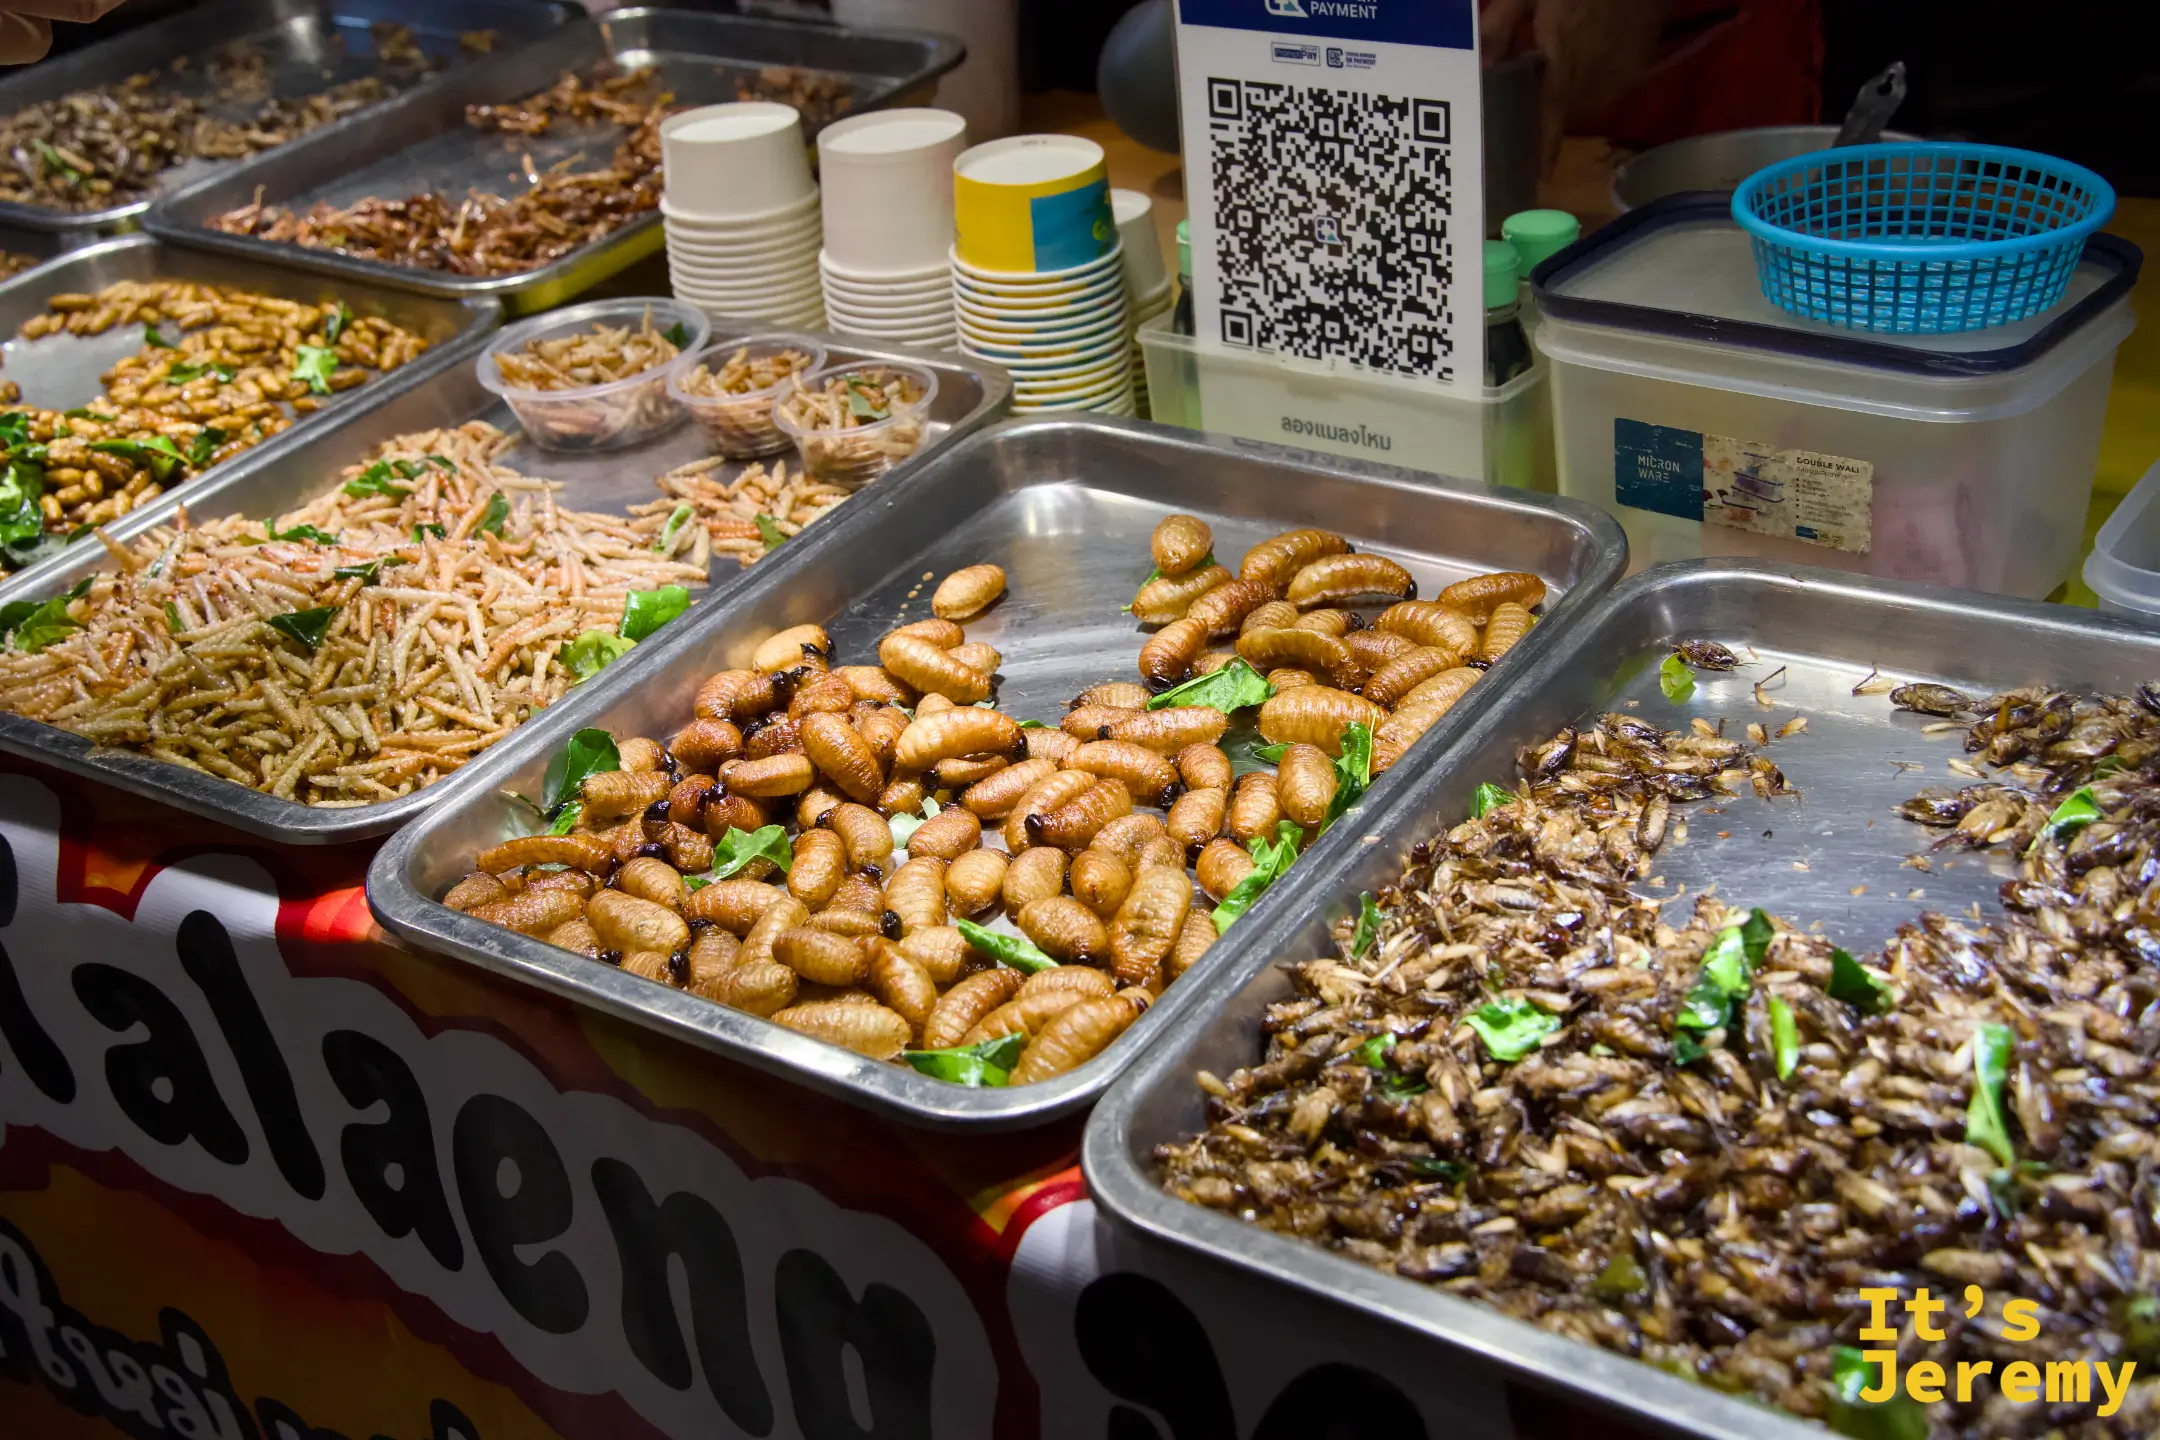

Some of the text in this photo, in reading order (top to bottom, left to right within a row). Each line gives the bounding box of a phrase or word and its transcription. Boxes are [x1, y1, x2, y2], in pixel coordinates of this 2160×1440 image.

[1310, 0, 1378, 19] PAYMENT
[1638, 454, 1680, 472] MICRON
[1796, 457, 1833, 469] DOUBLE
[1638, 467, 1669, 483] WARE
